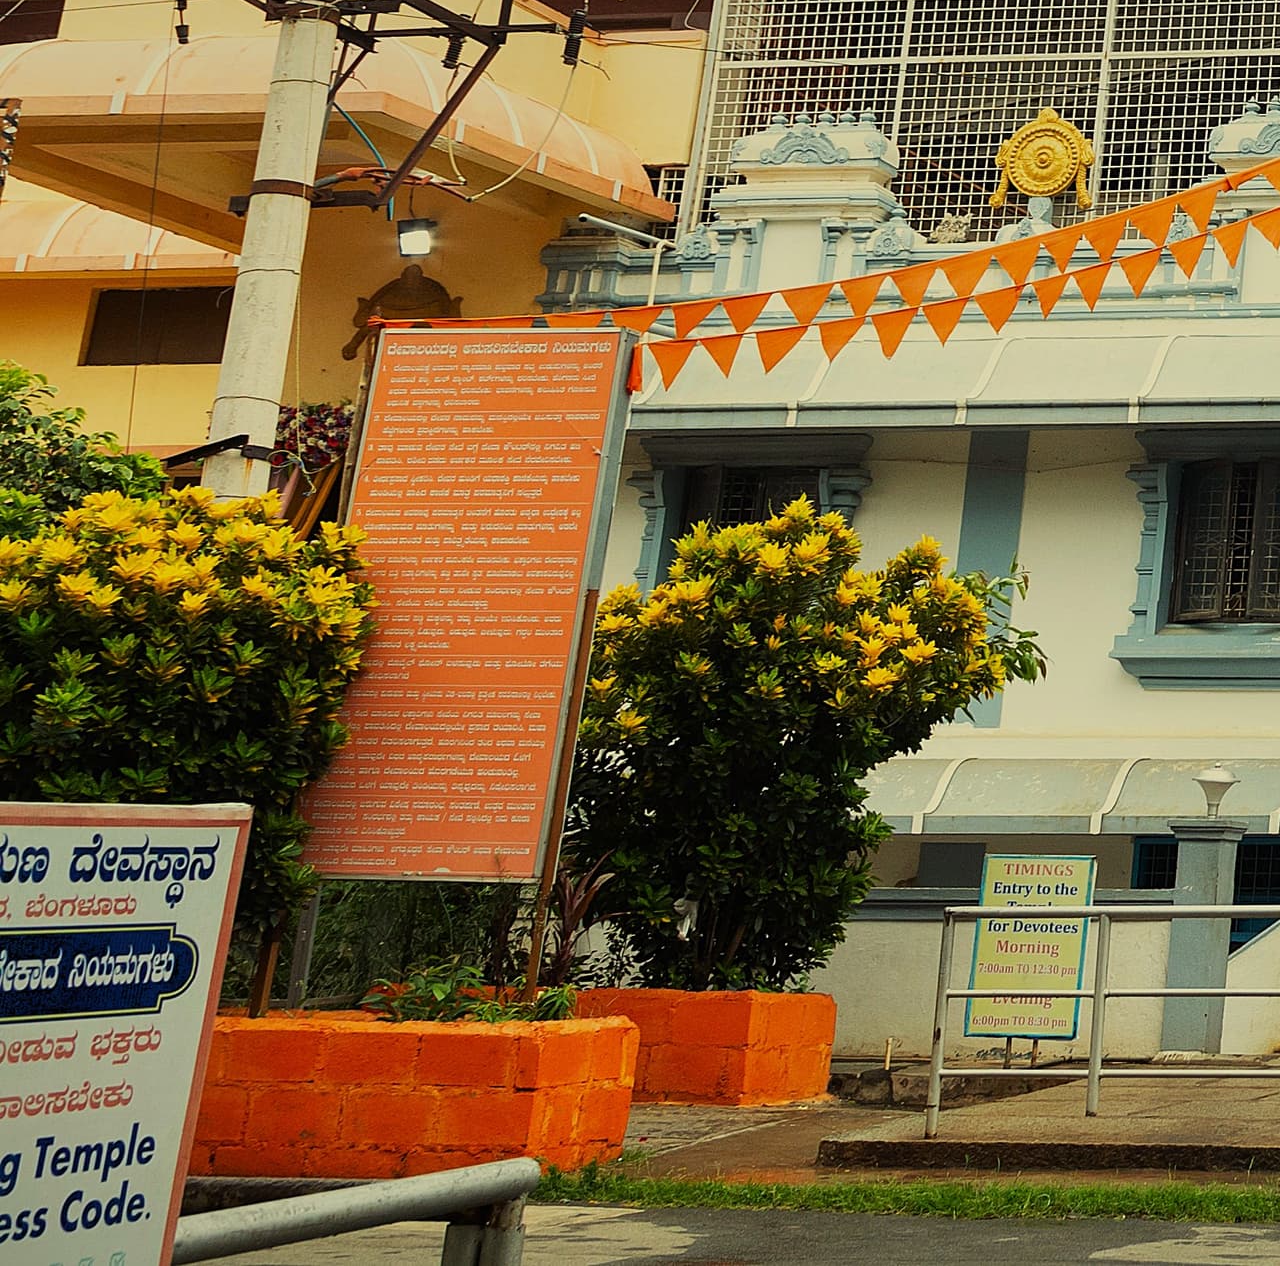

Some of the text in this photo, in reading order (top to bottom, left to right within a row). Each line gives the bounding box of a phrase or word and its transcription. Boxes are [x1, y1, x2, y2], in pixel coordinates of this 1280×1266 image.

[69, 833, 220, 909] ದೇವಸ್ಥಾನ
[1004, 863, 1074, 876] TIMINGS
[993, 881, 1078, 898] Entry to the
[25, 893, 137, 918] ಬೆಂಗಳೂರು
[987, 920, 1079, 934] for Devotees
[995, 940, 1060, 958] Morning
[67, 943, 175, 988] ನಿಯಮಗಳು
[978, 962, 1076, 978] 7:00am TO 12:30 pm
[972, 1015, 1067, 1028] 6:00pm TO 8:30 pm
[0, 1024, 162, 1065] ೀಡುವ ಭಕ್ತರು
[35, 1121, 156, 1183] Temple
[60, 1179, 151, 1233] Code.
